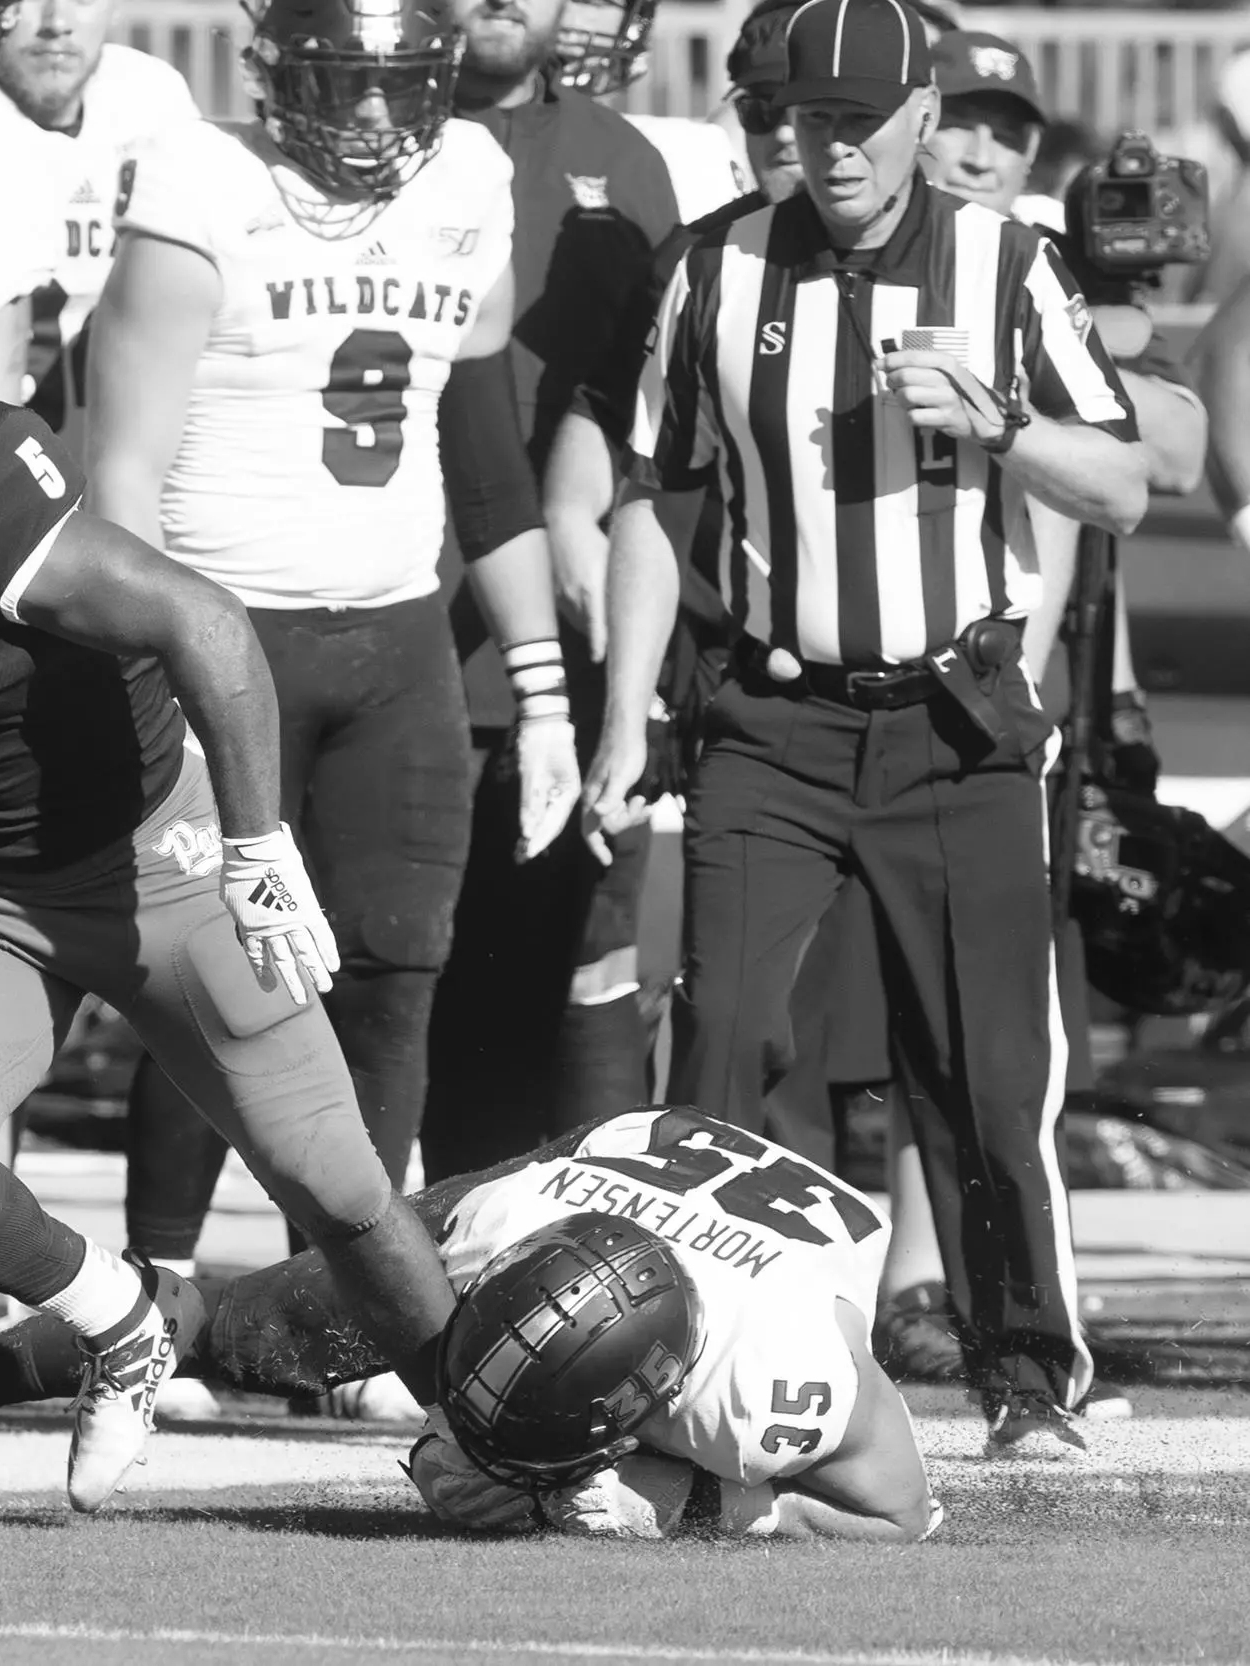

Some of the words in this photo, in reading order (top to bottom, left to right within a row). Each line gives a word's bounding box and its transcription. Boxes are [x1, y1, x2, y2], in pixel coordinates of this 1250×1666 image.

[266, 276, 472, 327] WILDCATS
[319, 328, 414, 488] 9
[14, 435, 66, 500] 5
[920, 427, 953, 470] L
[932, 647, 958, 673] L
[264, 866, 299, 913] adidas
[538, 1165, 784, 1280] MORTENSEN
[143, 1317, 178, 1430] adidas
[601, 1340, 685, 1433] 35
[760, 1379, 833, 1456] 35
